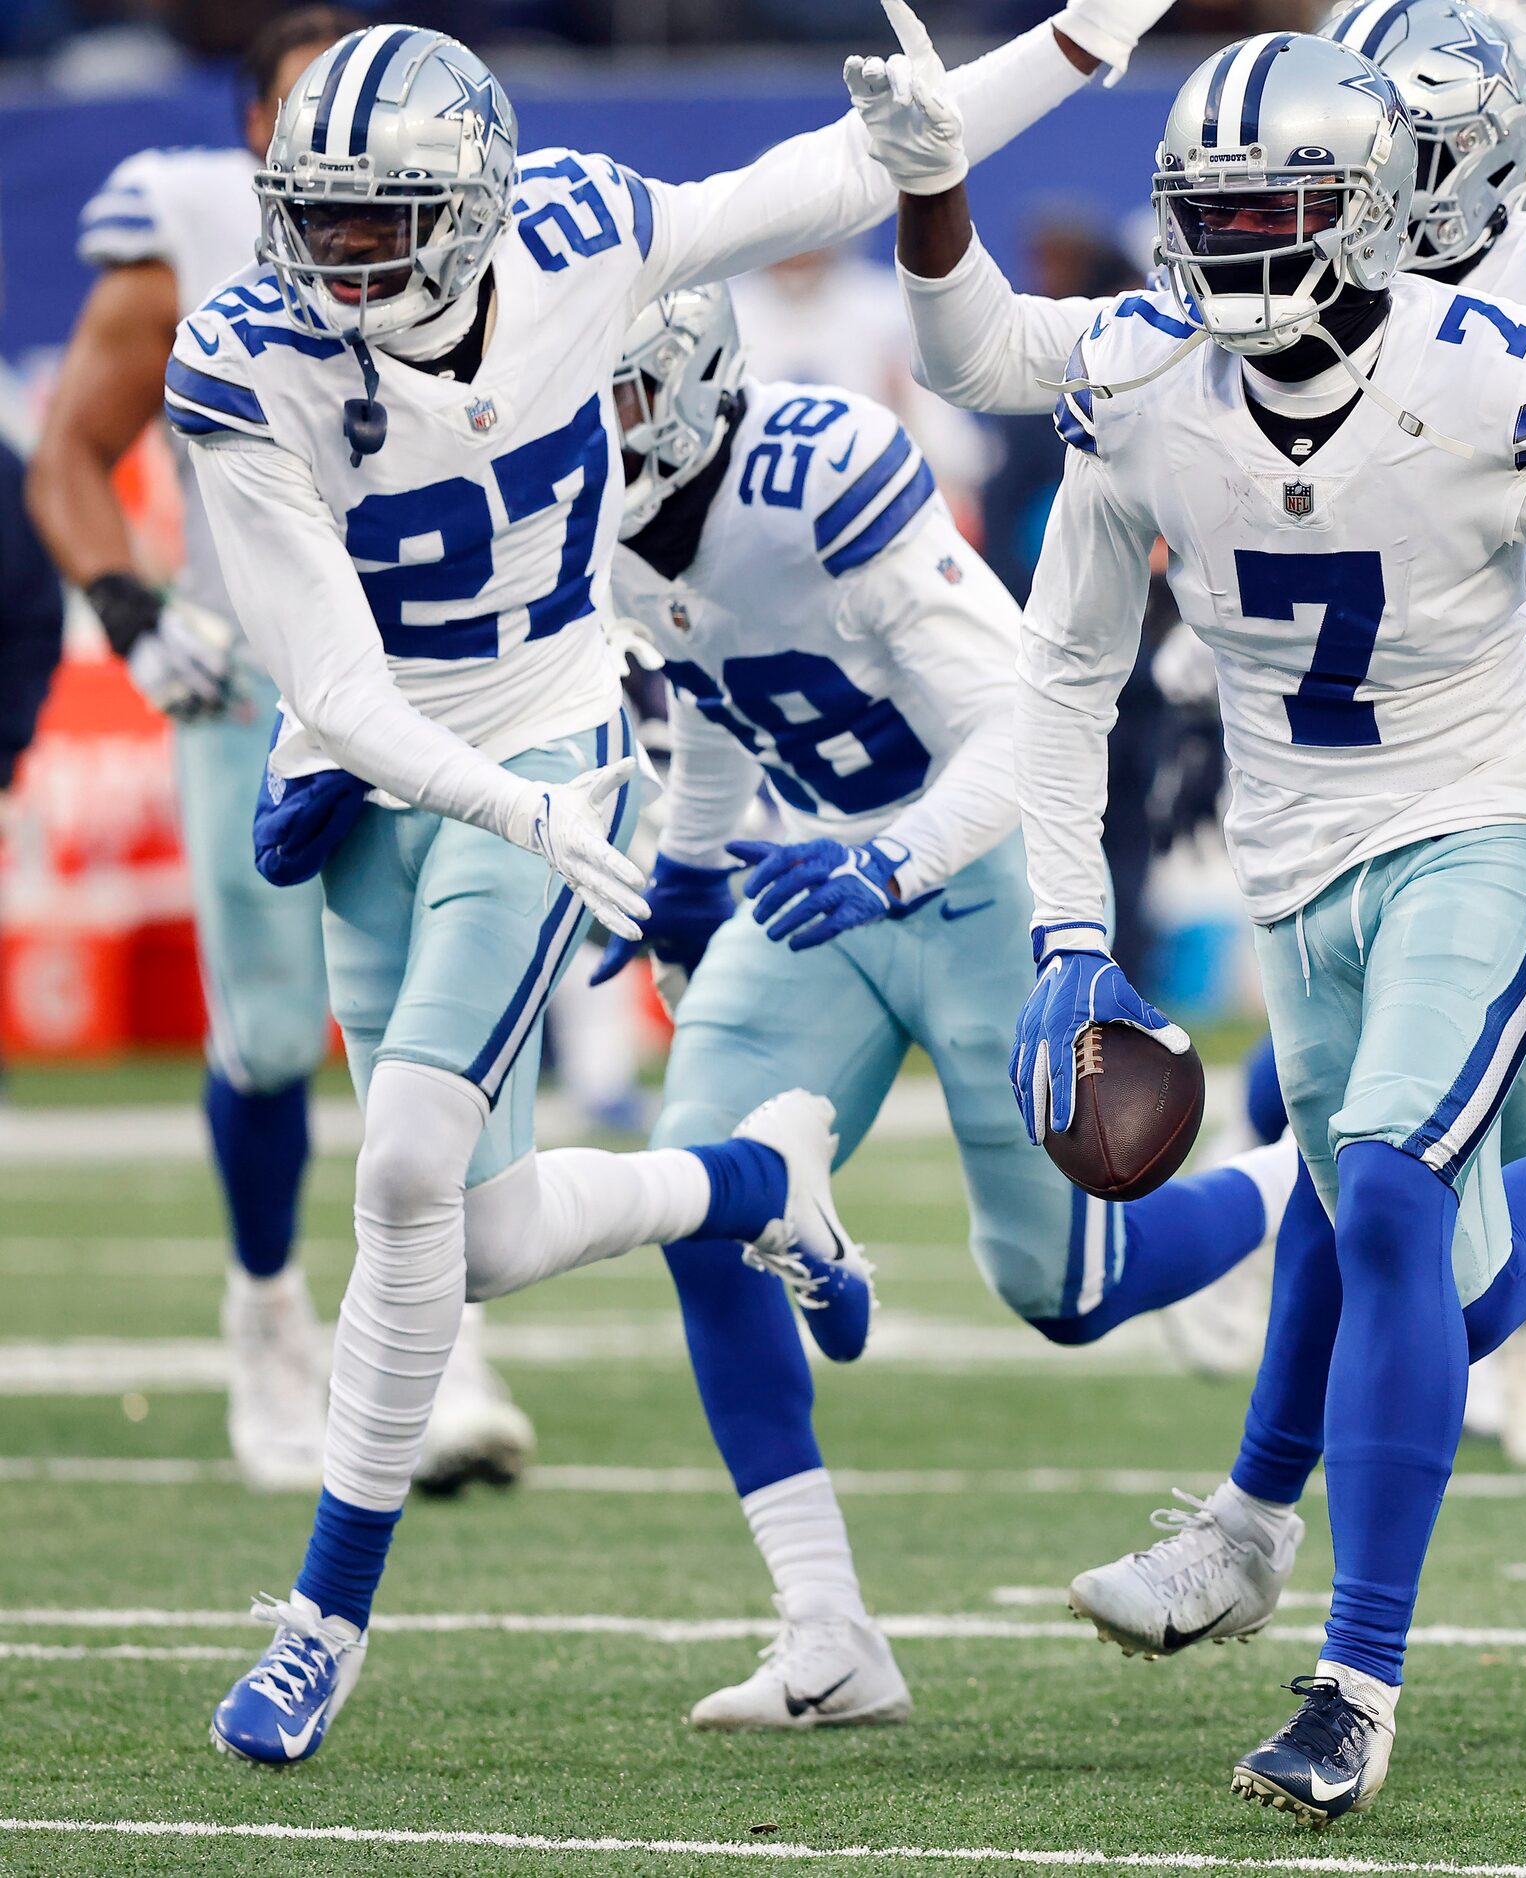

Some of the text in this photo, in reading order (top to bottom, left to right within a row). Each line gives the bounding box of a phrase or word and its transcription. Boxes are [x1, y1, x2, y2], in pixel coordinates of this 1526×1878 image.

[1209, 153, 1247, 163] COWBOYS
[738, 397, 850, 511] 28
[345, 392, 609, 660] 27
[1287, 496, 1310, 513] NFL
[1234, 550, 1387, 747] 7
[1156, 1067, 1172, 1113] NATIONAL
